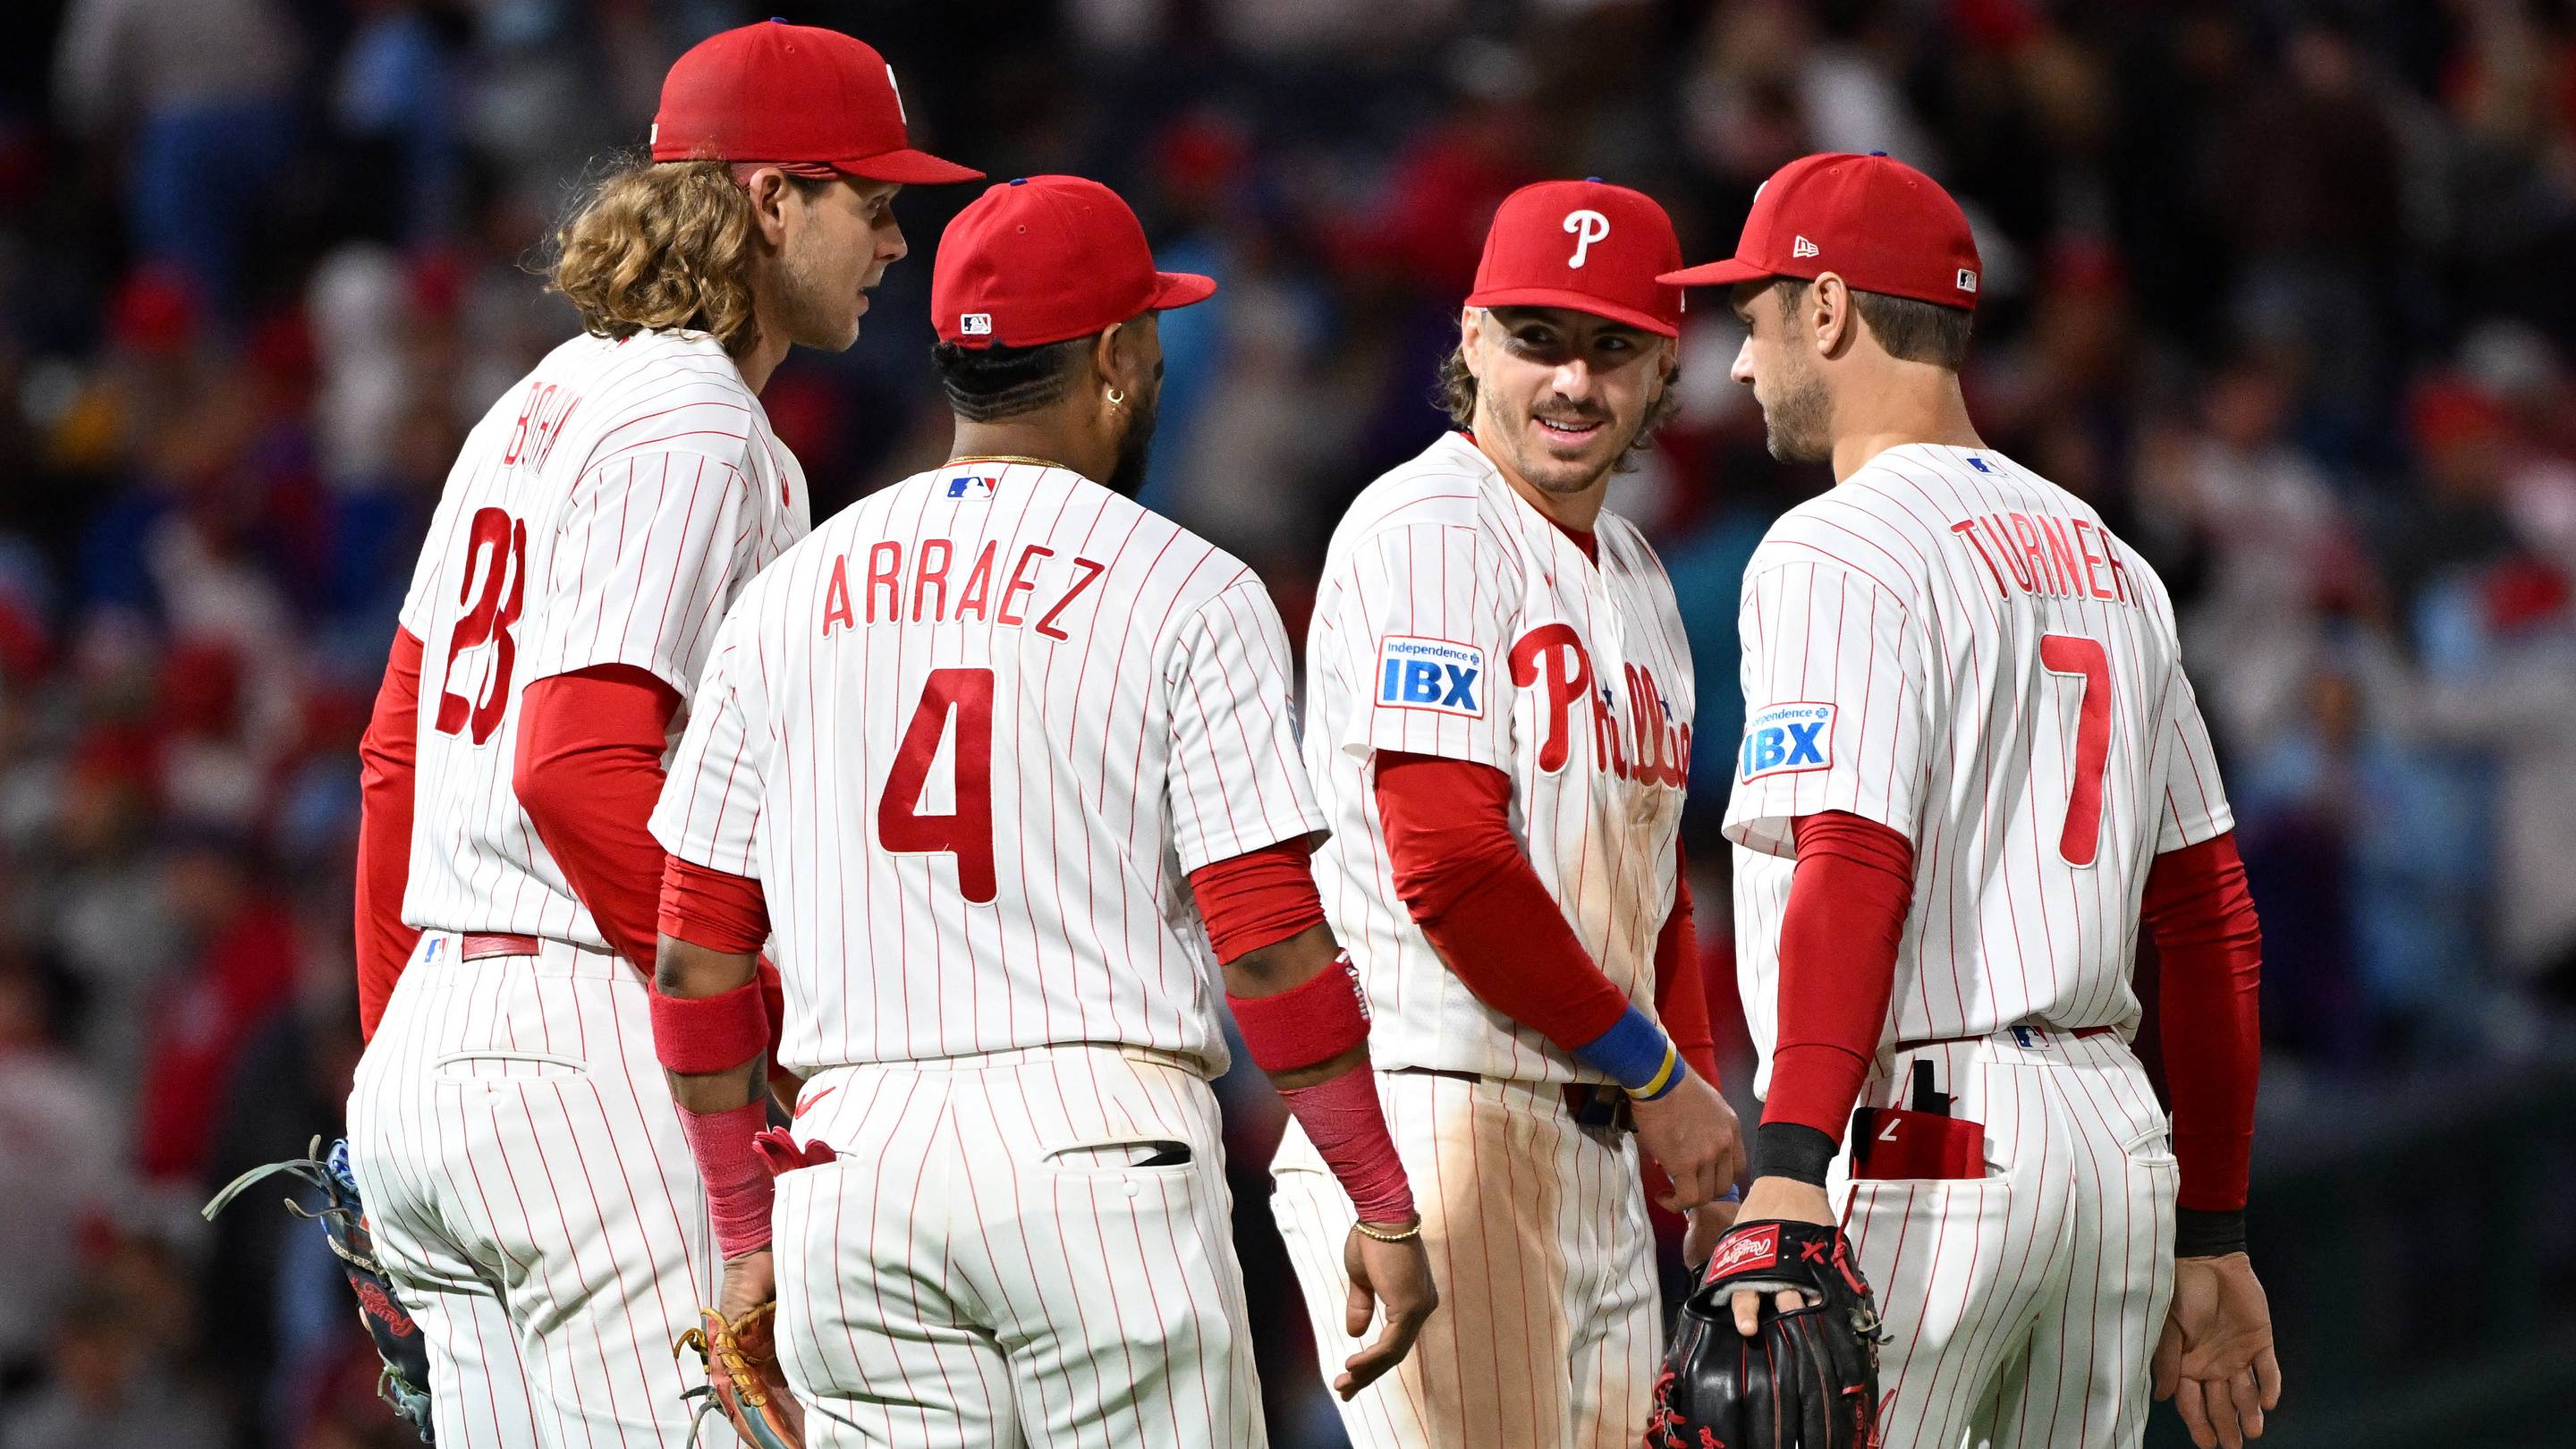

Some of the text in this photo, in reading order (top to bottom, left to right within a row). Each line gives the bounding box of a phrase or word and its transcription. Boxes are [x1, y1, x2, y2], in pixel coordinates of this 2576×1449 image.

[1563, 210, 1610, 268] P
[823, 539, 1106, 641] ARRAEZ
[1951, 513, 2138, 608] TURNER
[435, 507, 527, 745] 28
[1388, 642, 1469, 661] Independence
[1383, 658, 1479, 711] IBX
[1508, 623, 1691, 792] Phillie
[878, 668, 997, 903] 4
[1744, 722, 1826, 777] IBX
[2040, 634, 2112, 866] 7
